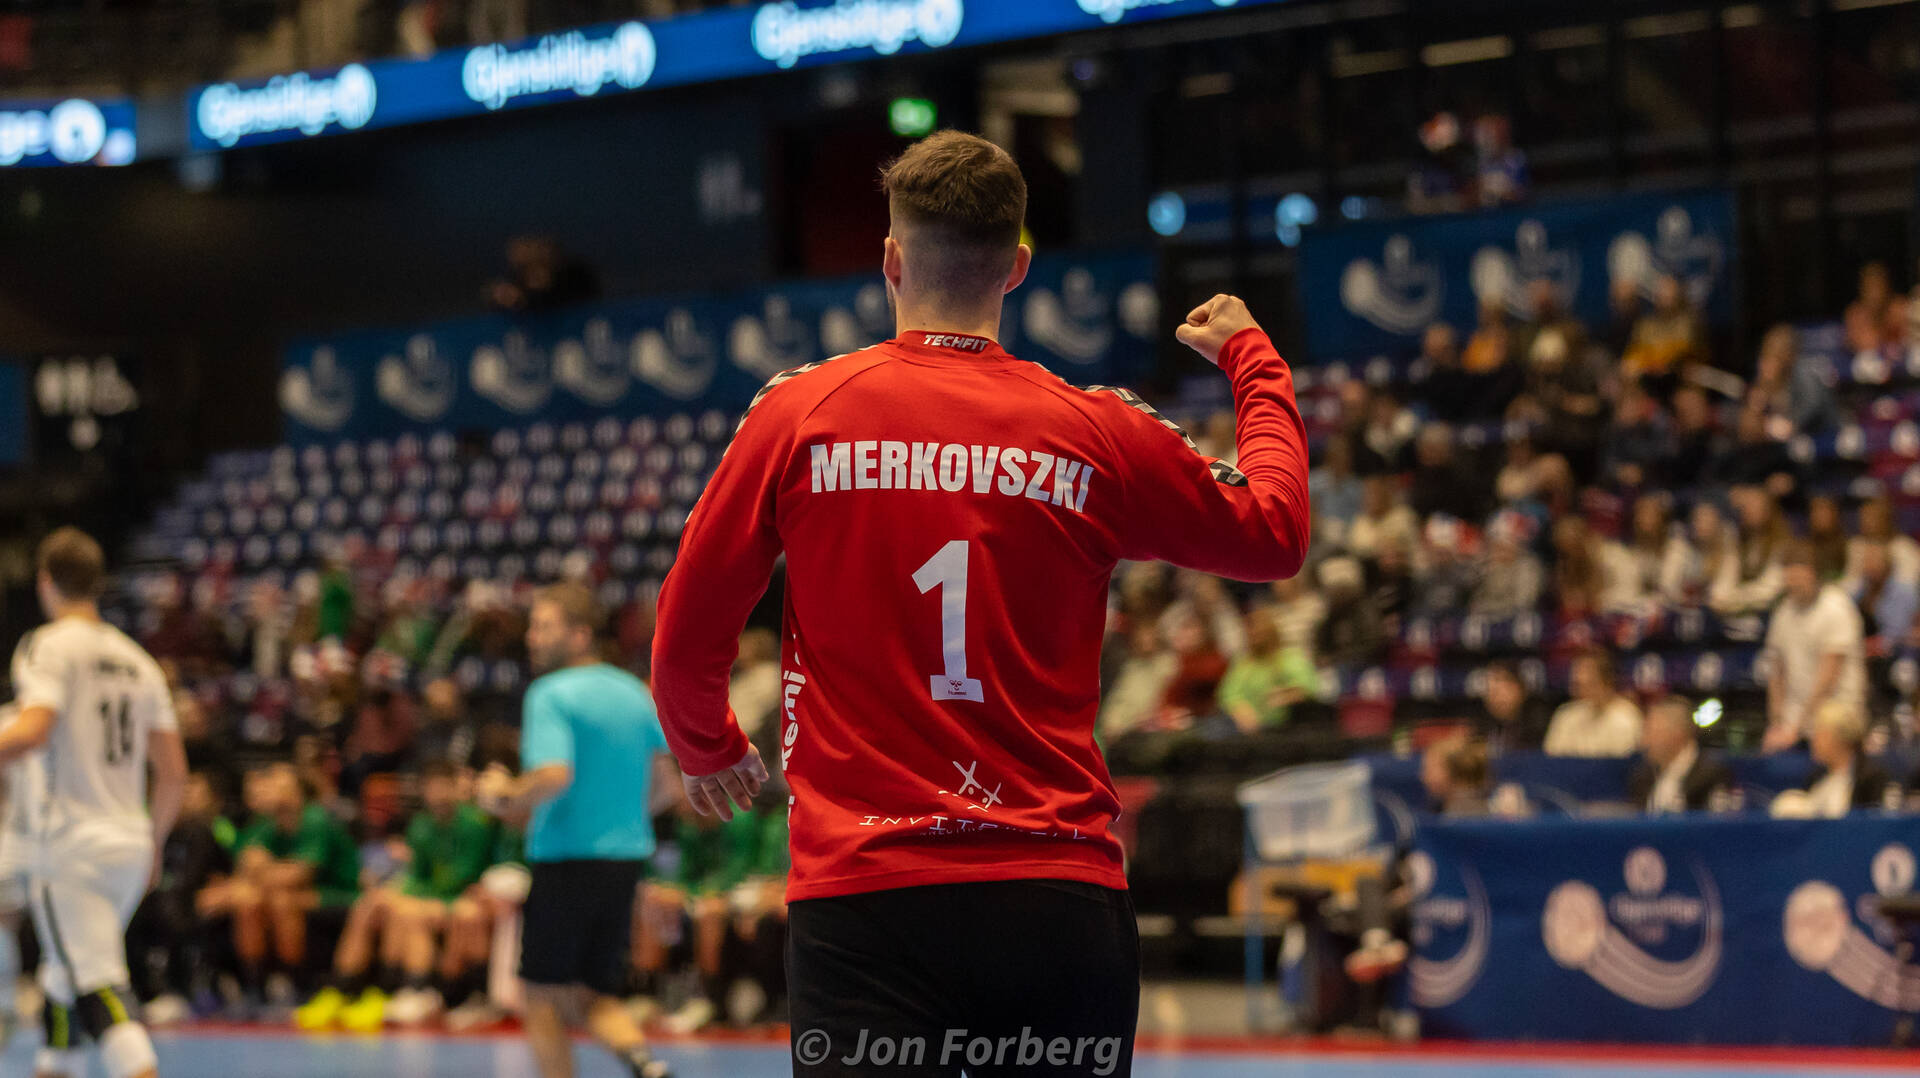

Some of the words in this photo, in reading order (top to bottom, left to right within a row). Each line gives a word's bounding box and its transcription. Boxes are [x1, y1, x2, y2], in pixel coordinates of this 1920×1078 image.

[923, 334, 989, 352] TECHFIT
[810, 440, 1094, 513] MERKOVSZKI
[911, 539, 985, 704] 1
